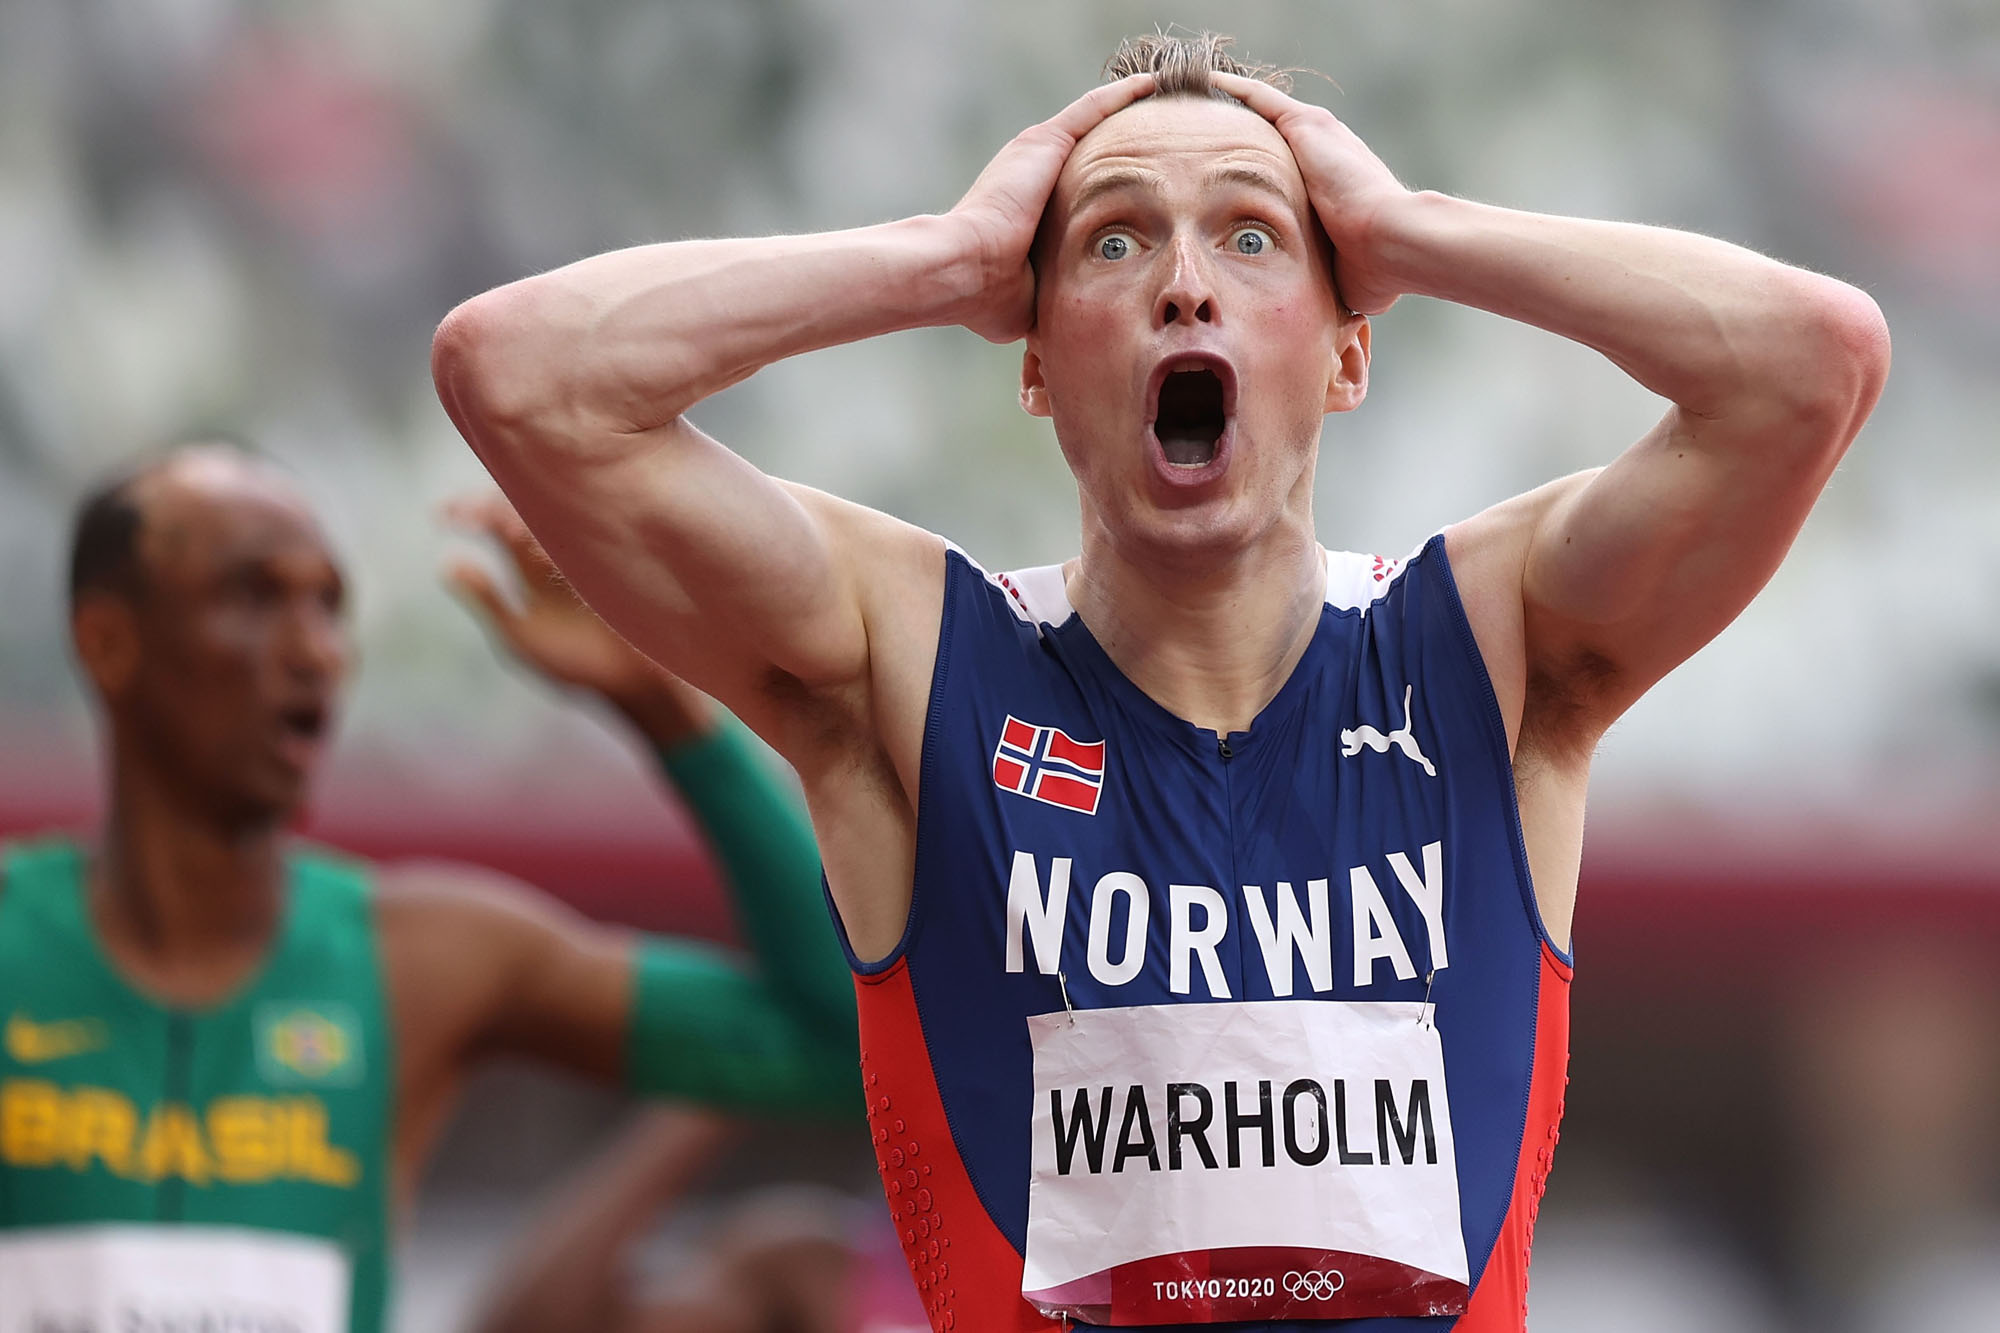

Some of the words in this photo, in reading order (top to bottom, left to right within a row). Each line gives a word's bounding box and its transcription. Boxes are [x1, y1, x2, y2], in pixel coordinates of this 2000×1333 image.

[1005, 841, 1448, 998] NORWAY
[0, 1077, 361, 1188] BRASIL
[1050, 1078, 1438, 1176] WARHOLM
[1153, 1279, 1221, 1301] TOKYO
[1225, 1277, 1275, 1298] 2020
